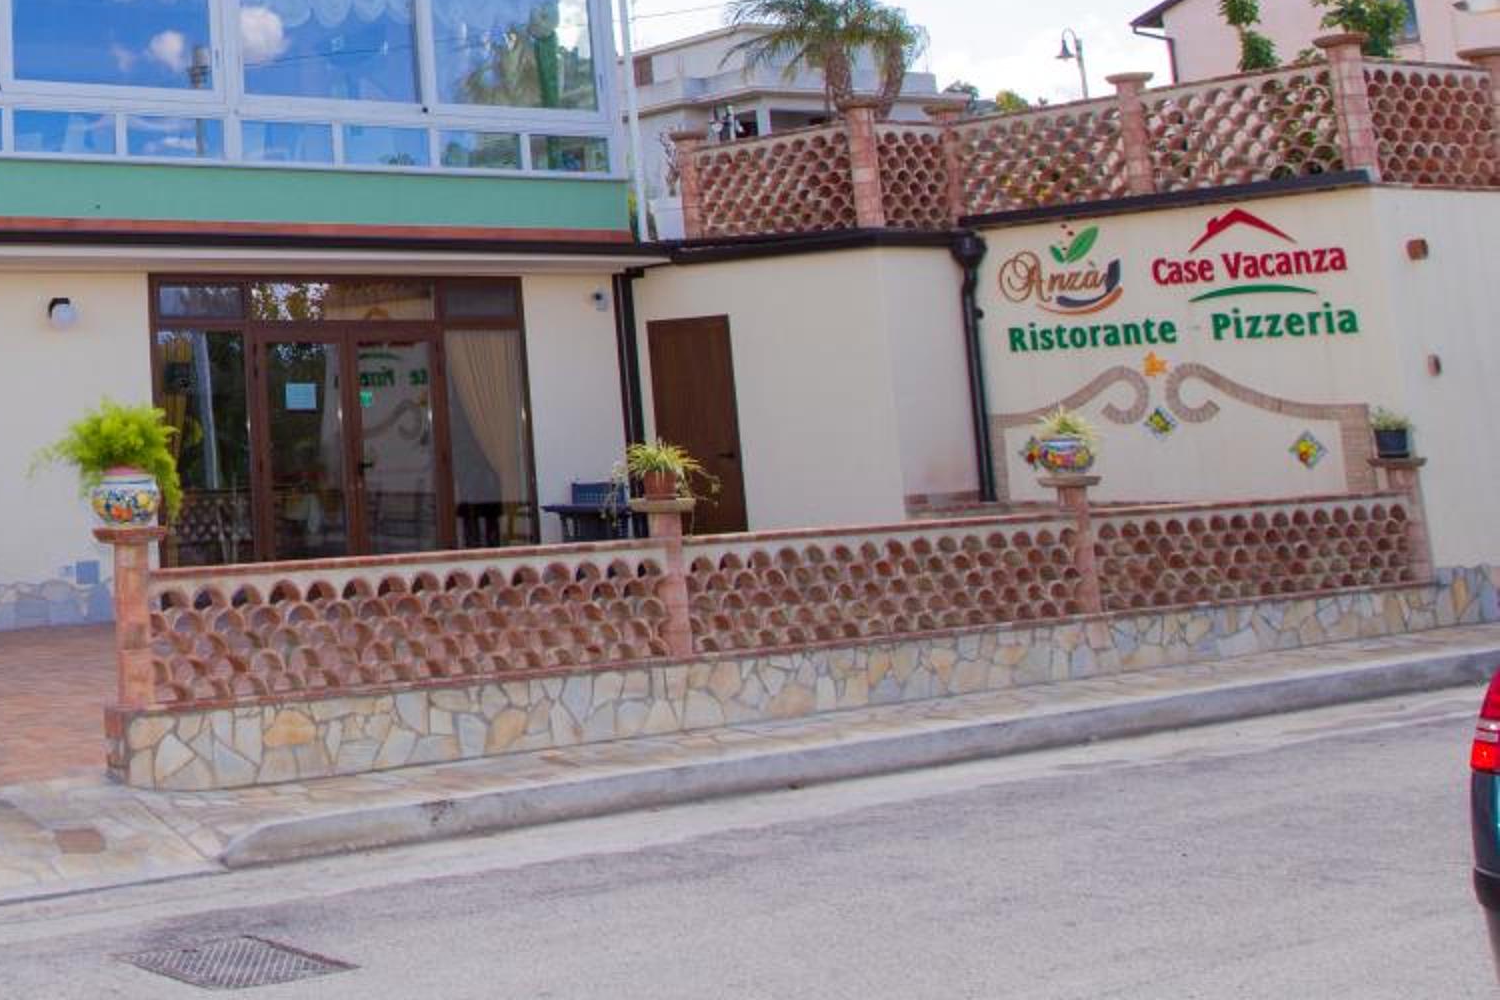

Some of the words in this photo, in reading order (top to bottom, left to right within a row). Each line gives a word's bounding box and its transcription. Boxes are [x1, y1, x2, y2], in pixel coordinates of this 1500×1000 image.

[1152, 258, 1214, 286] Case
[1221, 247, 1349, 280] Vacanza
[1008, 318, 1177, 352] Ristorante
[1211, 301, 1359, 340] Pizzeria
